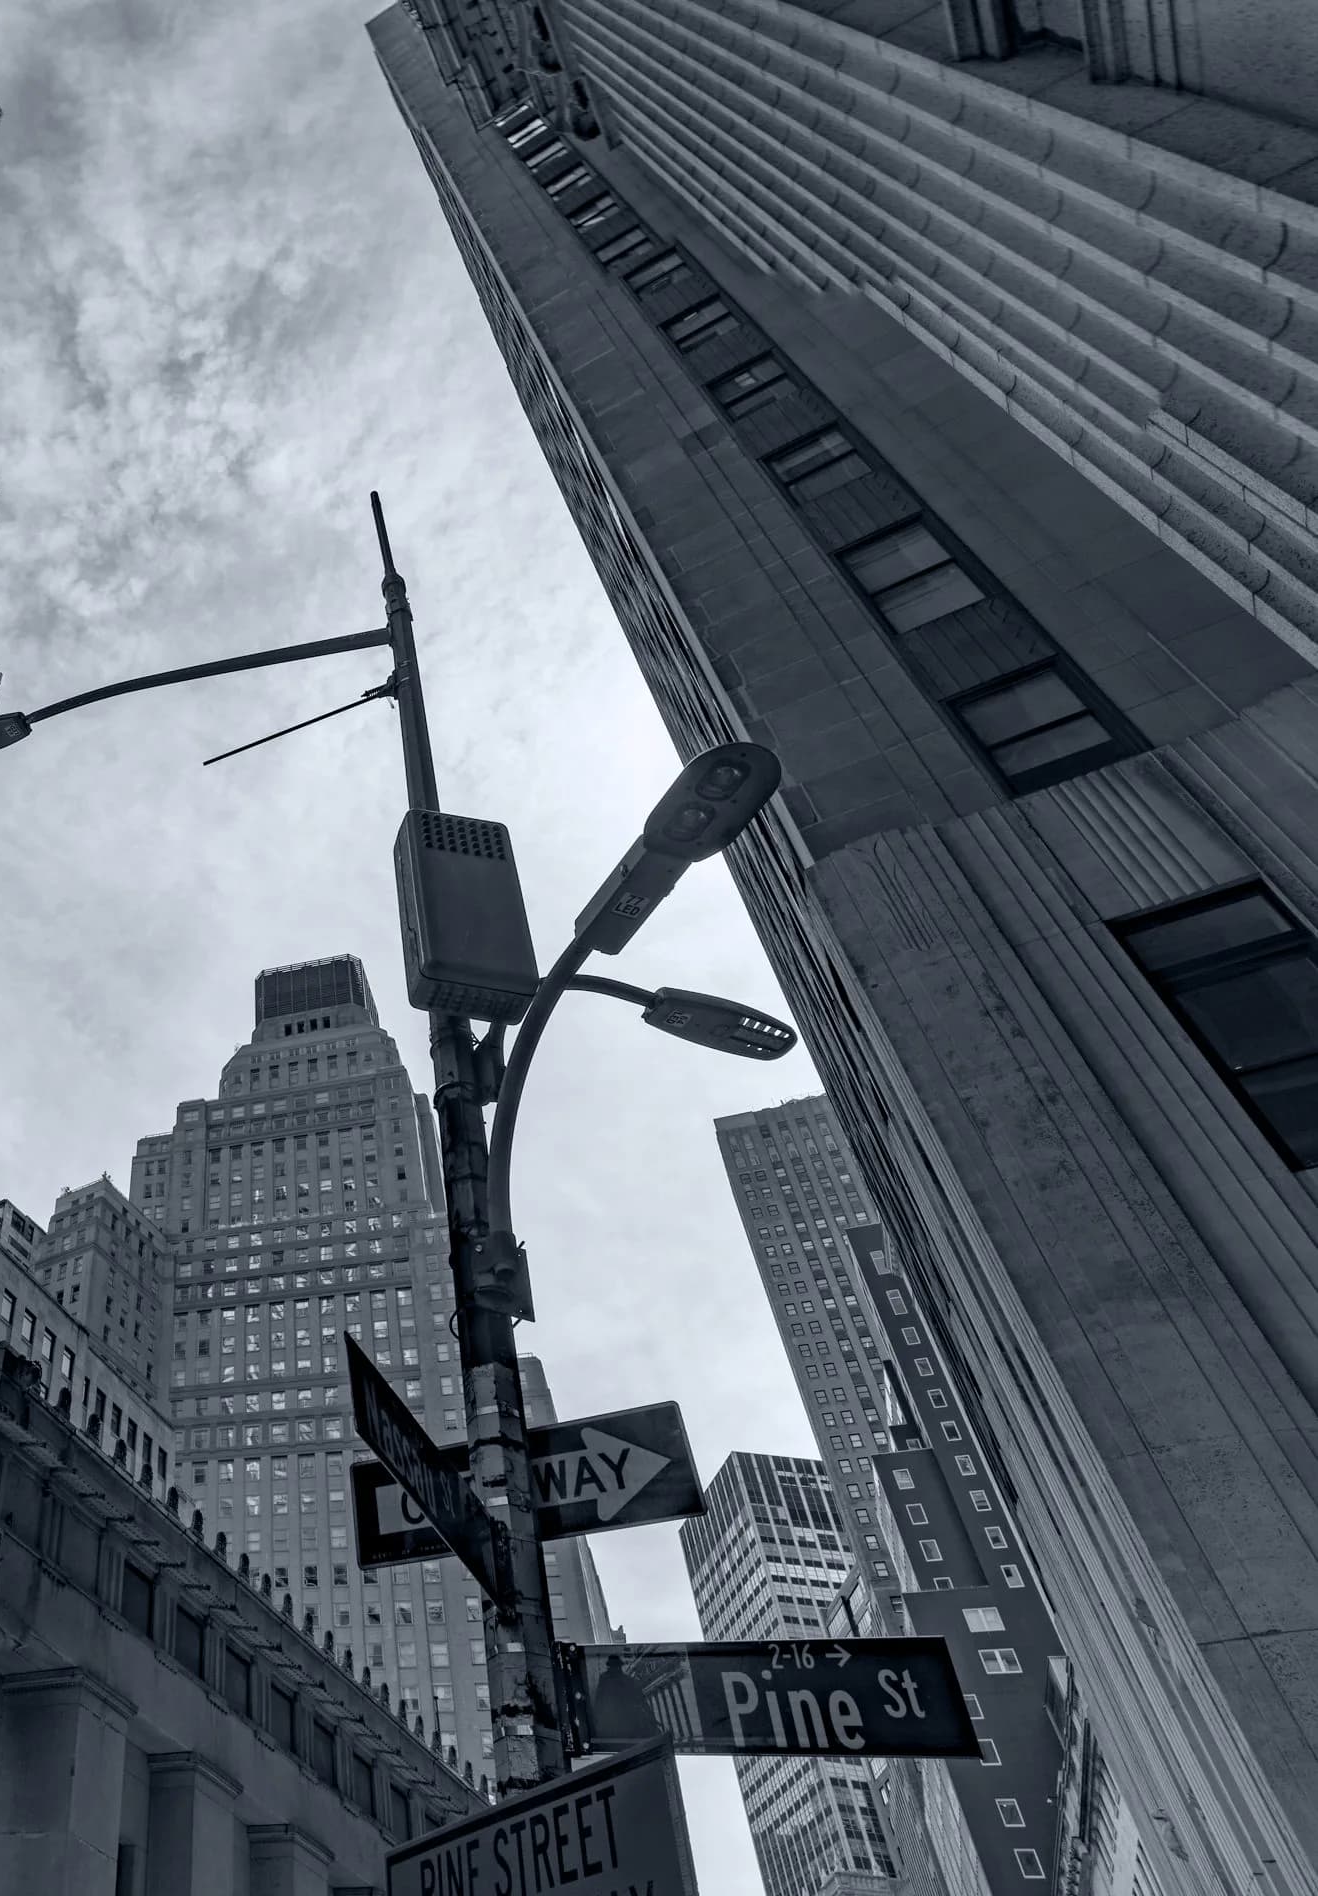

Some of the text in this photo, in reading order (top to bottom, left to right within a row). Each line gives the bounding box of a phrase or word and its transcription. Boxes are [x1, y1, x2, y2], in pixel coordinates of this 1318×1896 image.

[614, 902, 640, 915] LED
[626, 894, 644, 906] 77
[364, 1375, 439, 1519] Nassau
[440, 1469, 456, 1519] St
[531, 1448, 631, 1502] WAY
[768, 1643, 815, 1670] 2-16
[720, 1669, 926, 1750] Pine St
[493, 1785, 619, 1896] STREET
